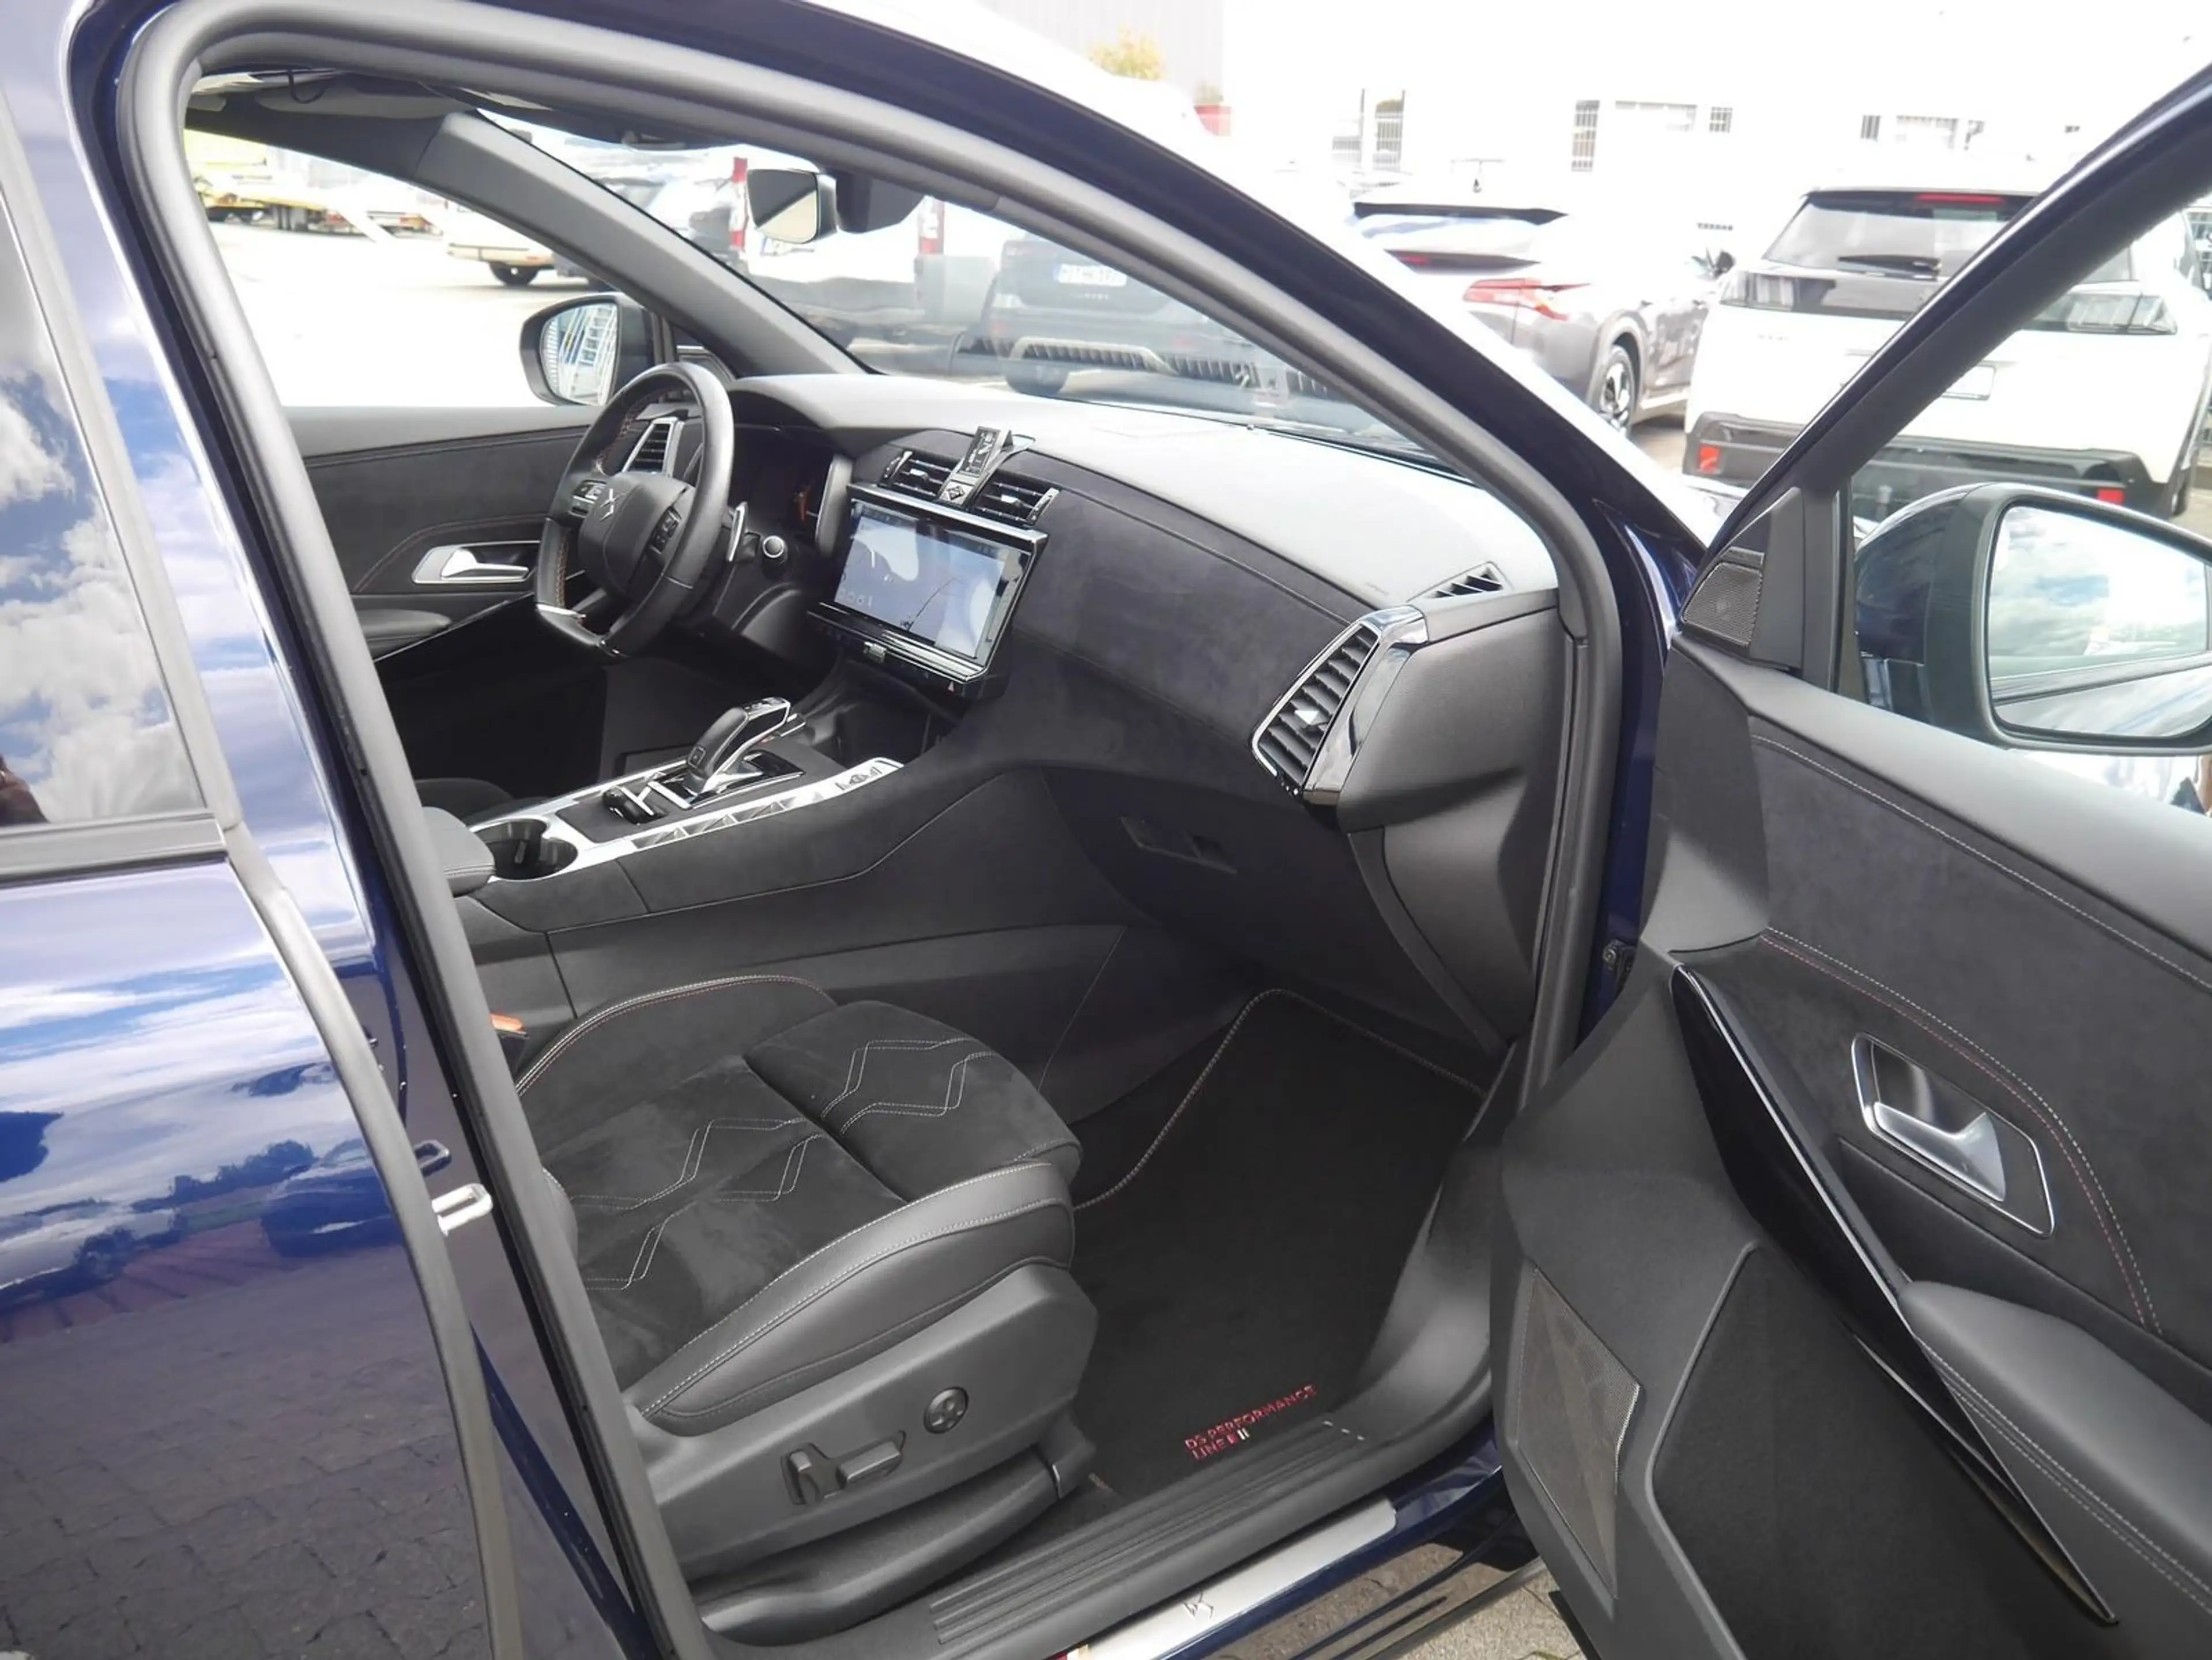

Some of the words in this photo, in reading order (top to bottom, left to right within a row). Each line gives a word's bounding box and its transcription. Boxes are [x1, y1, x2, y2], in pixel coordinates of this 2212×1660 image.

[1185, 1435, 1207, 1450] DS
[1207, 1384, 1317, 1439] PERFORMANCE
[1192, 1439, 1227, 1461] LINE
